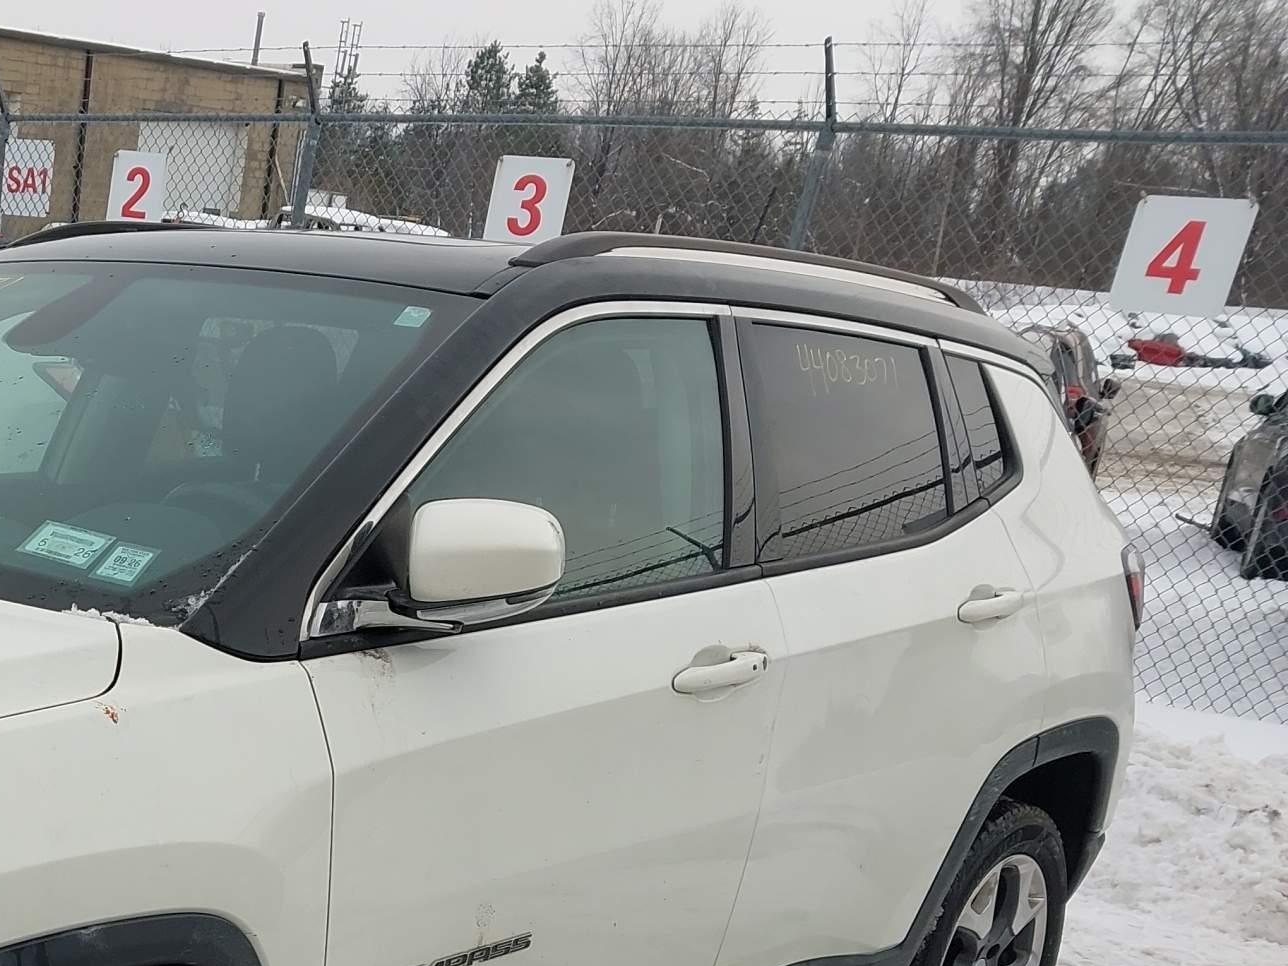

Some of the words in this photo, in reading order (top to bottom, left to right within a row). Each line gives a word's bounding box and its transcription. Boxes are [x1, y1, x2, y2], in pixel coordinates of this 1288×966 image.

[6, 165, 49, 194] SA1
[120, 166, 151, 219] 2
[506, 173, 548, 237] 3
[1144, 219, 1208, 295] 4
[795, 343, 900, 398] 44083071
